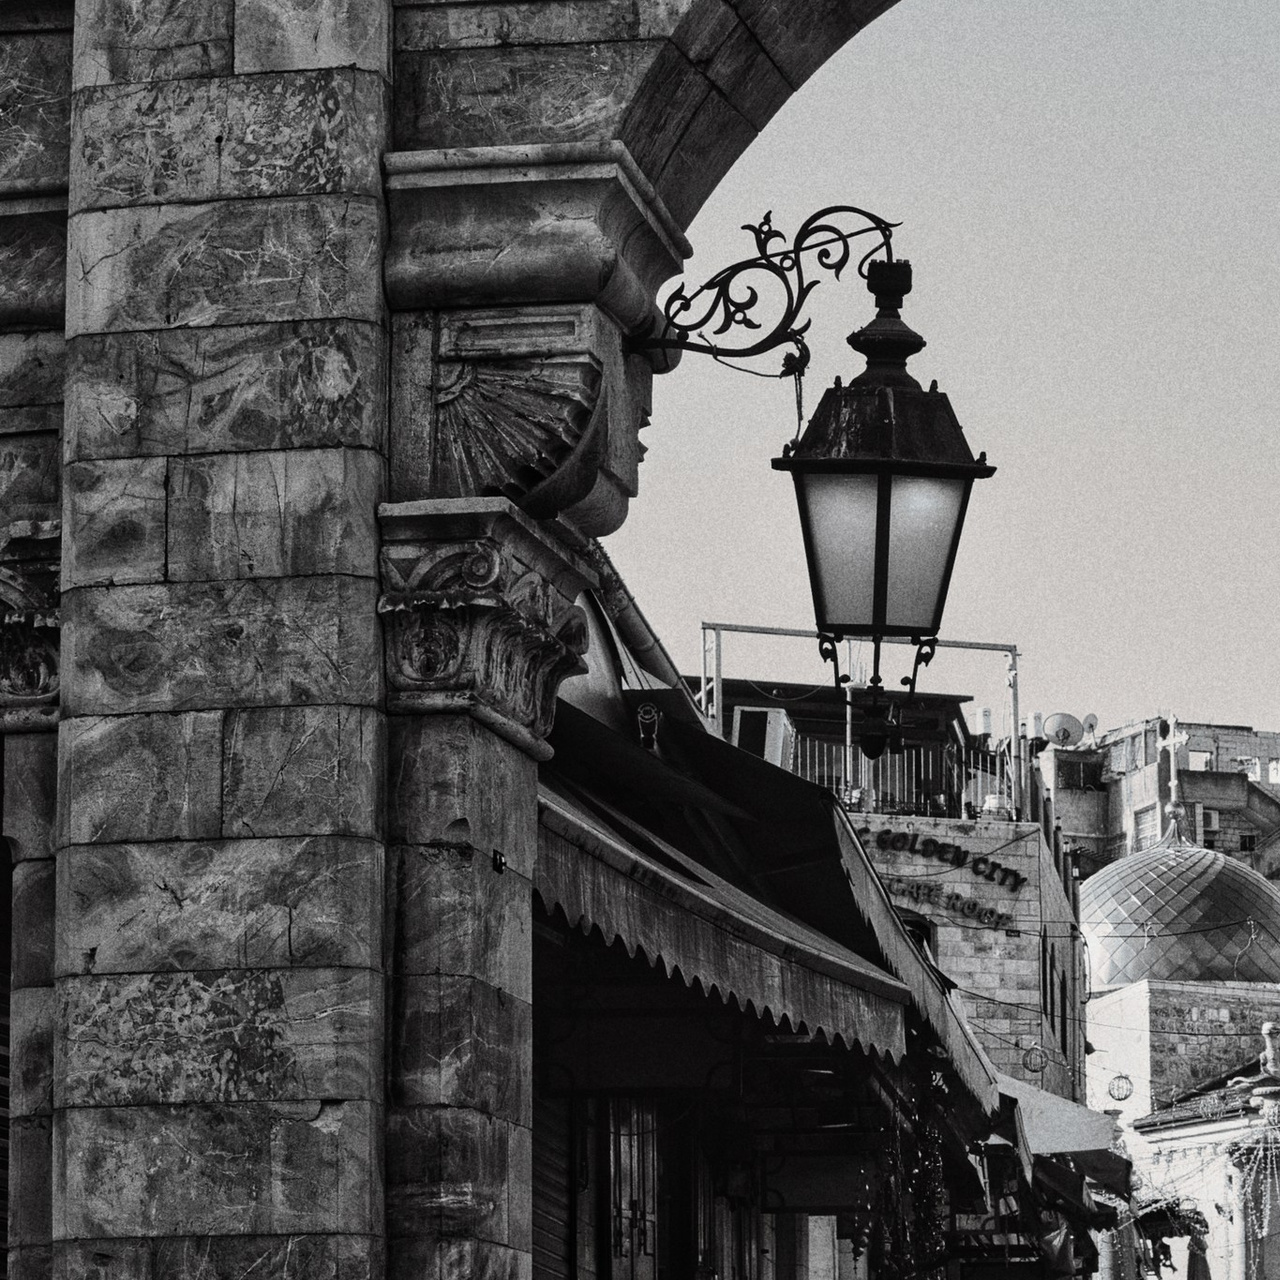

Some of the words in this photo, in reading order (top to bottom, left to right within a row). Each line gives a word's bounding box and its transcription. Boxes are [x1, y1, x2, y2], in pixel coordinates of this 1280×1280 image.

[876, 828, 970, 867] GOLDEN
[971, 856, 1027, 893] CITY
[946, 893, 1013, 930] ROOF
